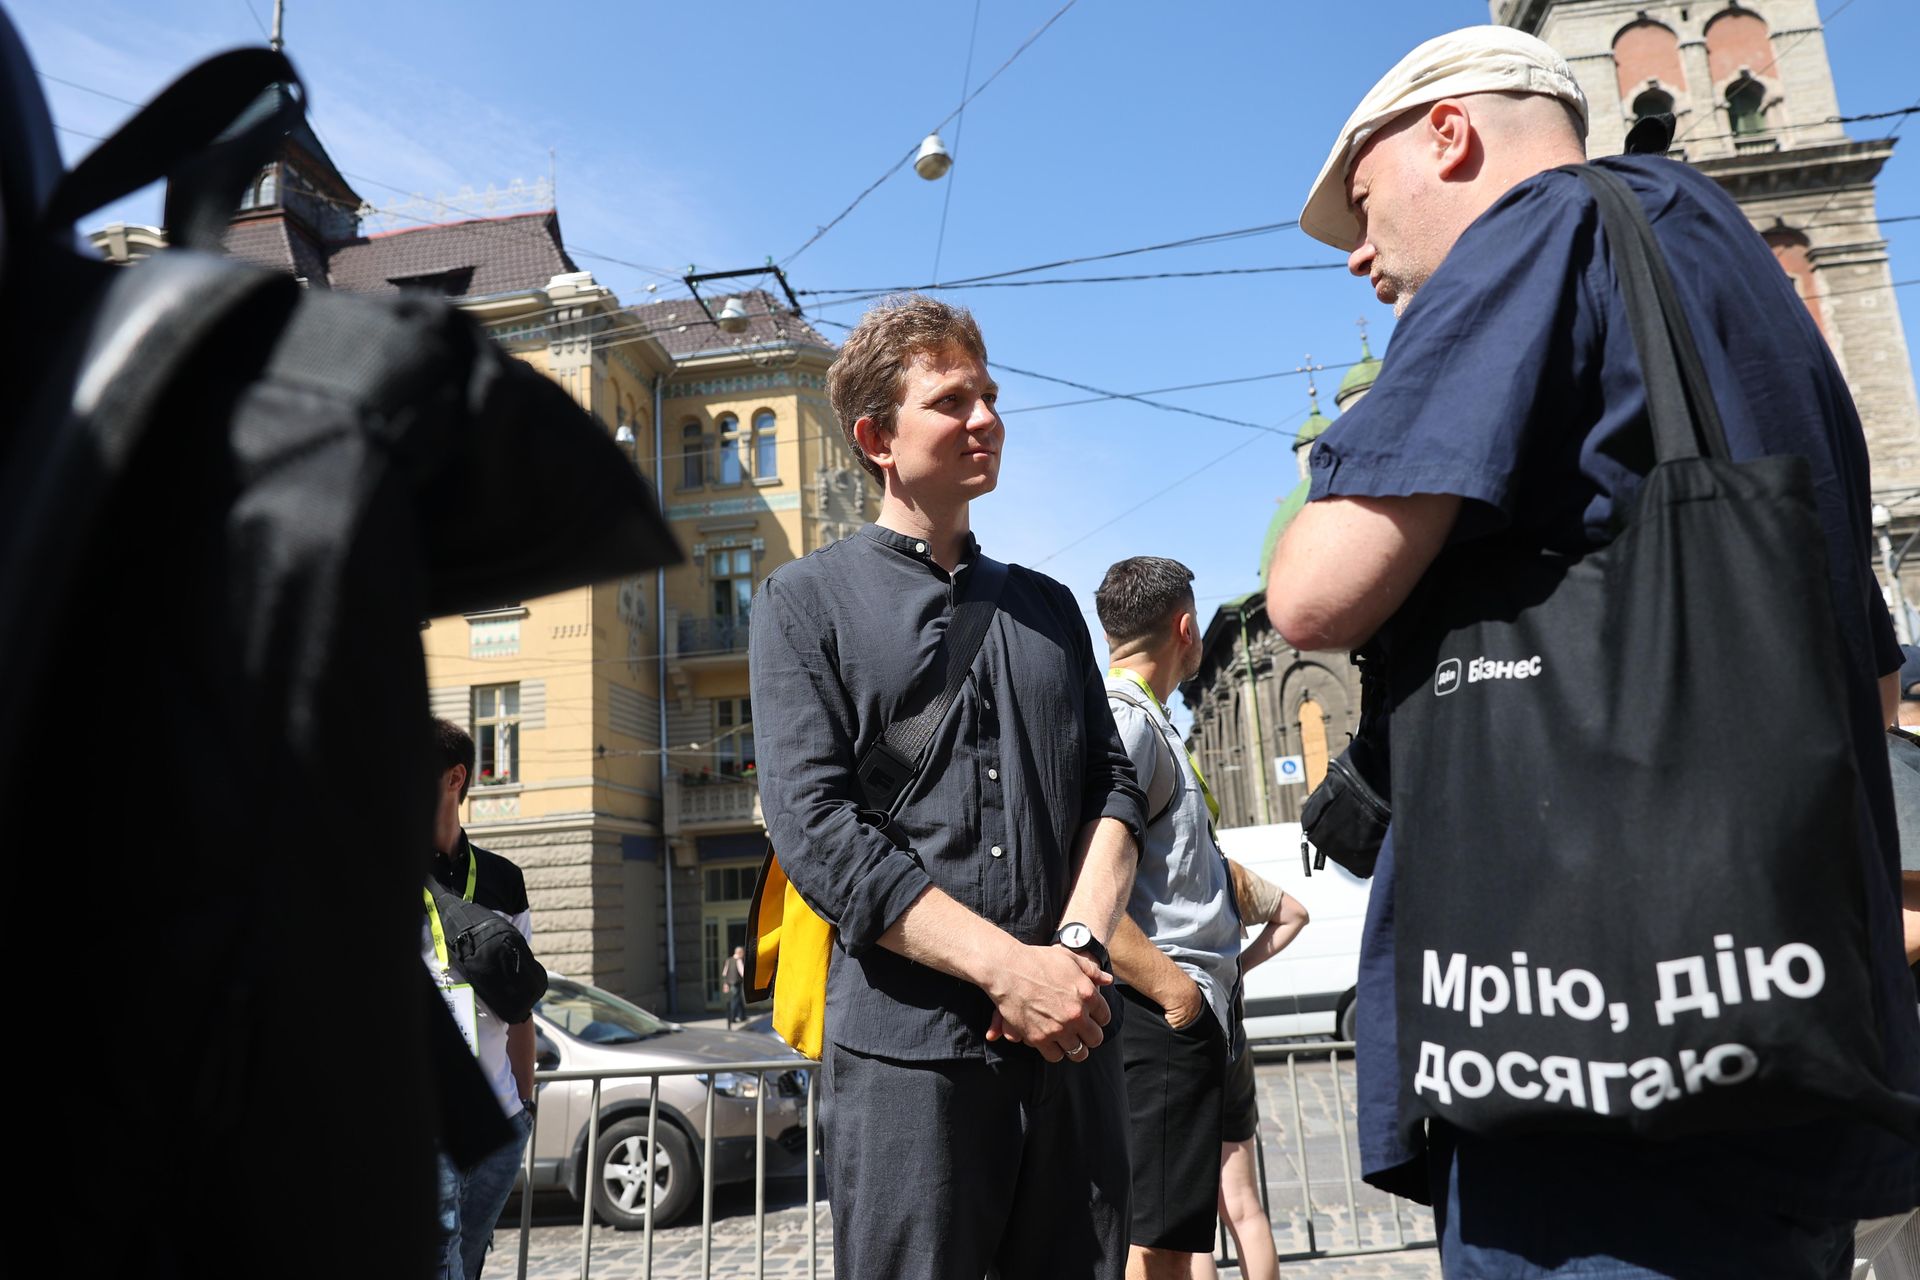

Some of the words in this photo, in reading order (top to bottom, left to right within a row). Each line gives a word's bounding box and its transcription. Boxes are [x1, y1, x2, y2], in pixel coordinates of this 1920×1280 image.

[1467, 656, 1542, 683] Бізнес
[1421, 949, 1630, 1033] Мрію,
[1655, 933, 1826, 1026] дію
[1413, 1040, 1759, 1115] досягаю
